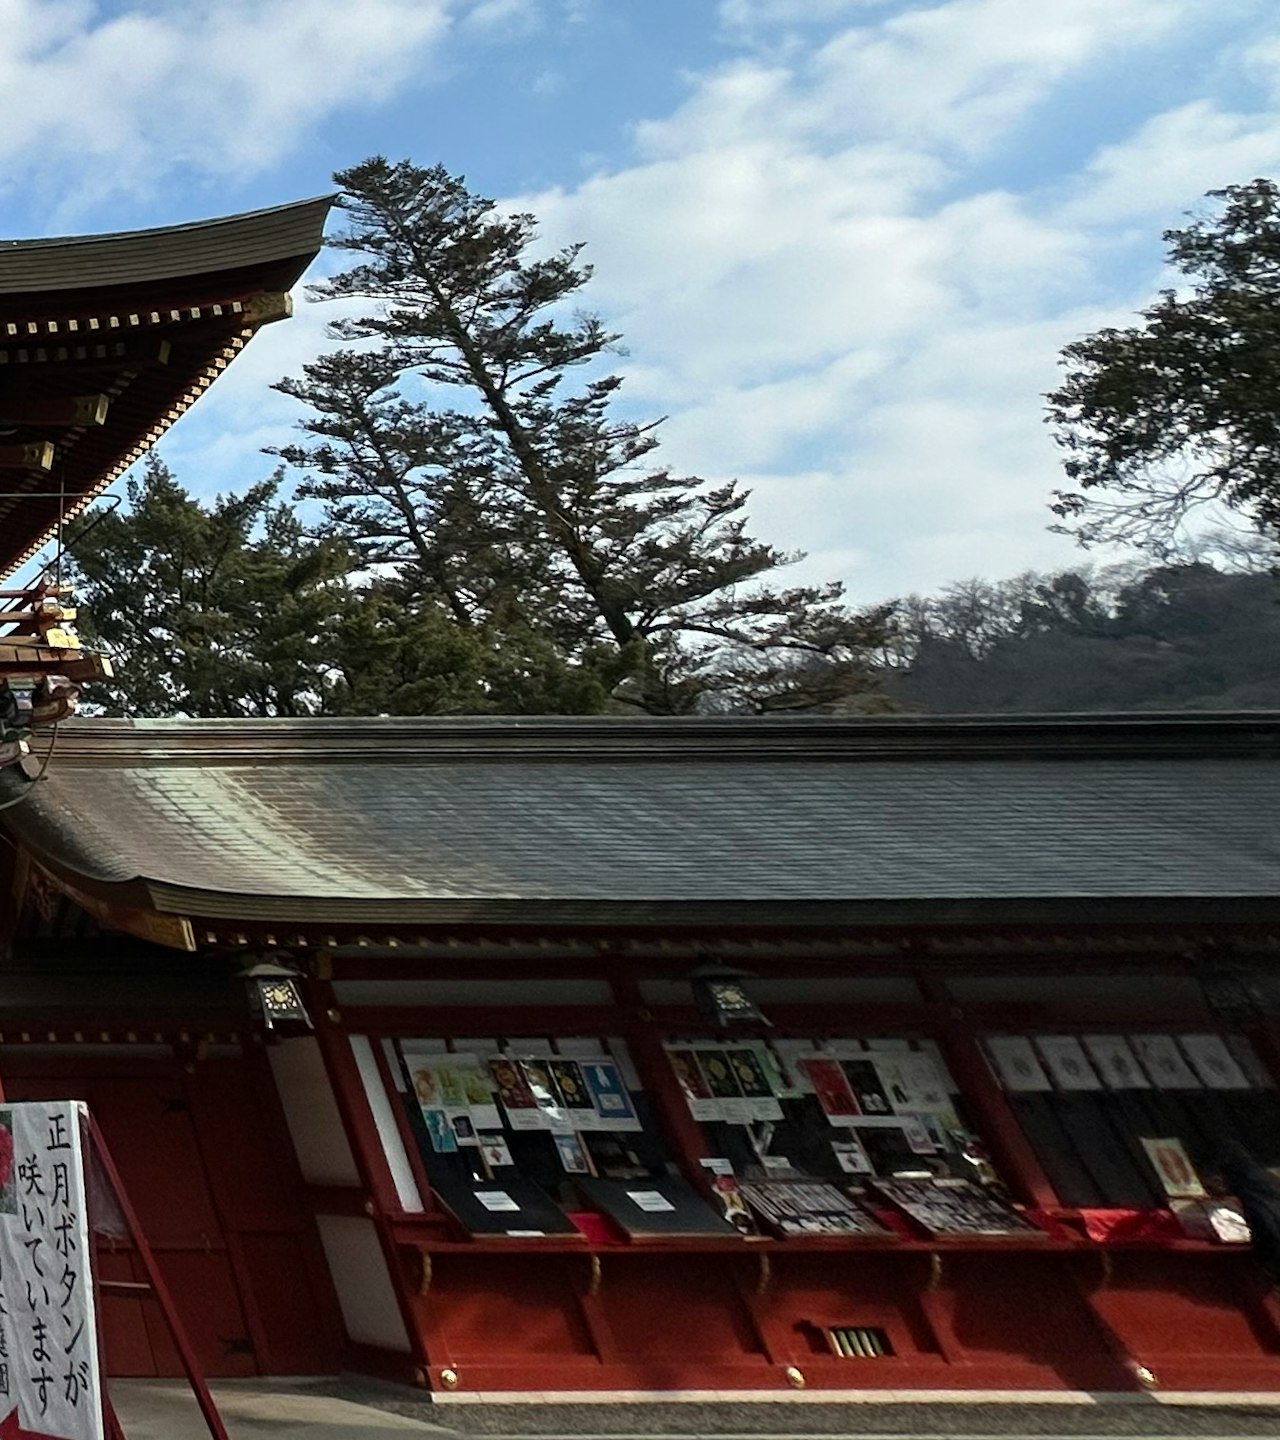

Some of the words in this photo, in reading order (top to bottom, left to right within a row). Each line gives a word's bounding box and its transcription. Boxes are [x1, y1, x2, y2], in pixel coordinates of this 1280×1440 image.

[17, 1154, 54, 1417] 咲いています
[46, 1113, 89, 1407] 正月ボタンが
